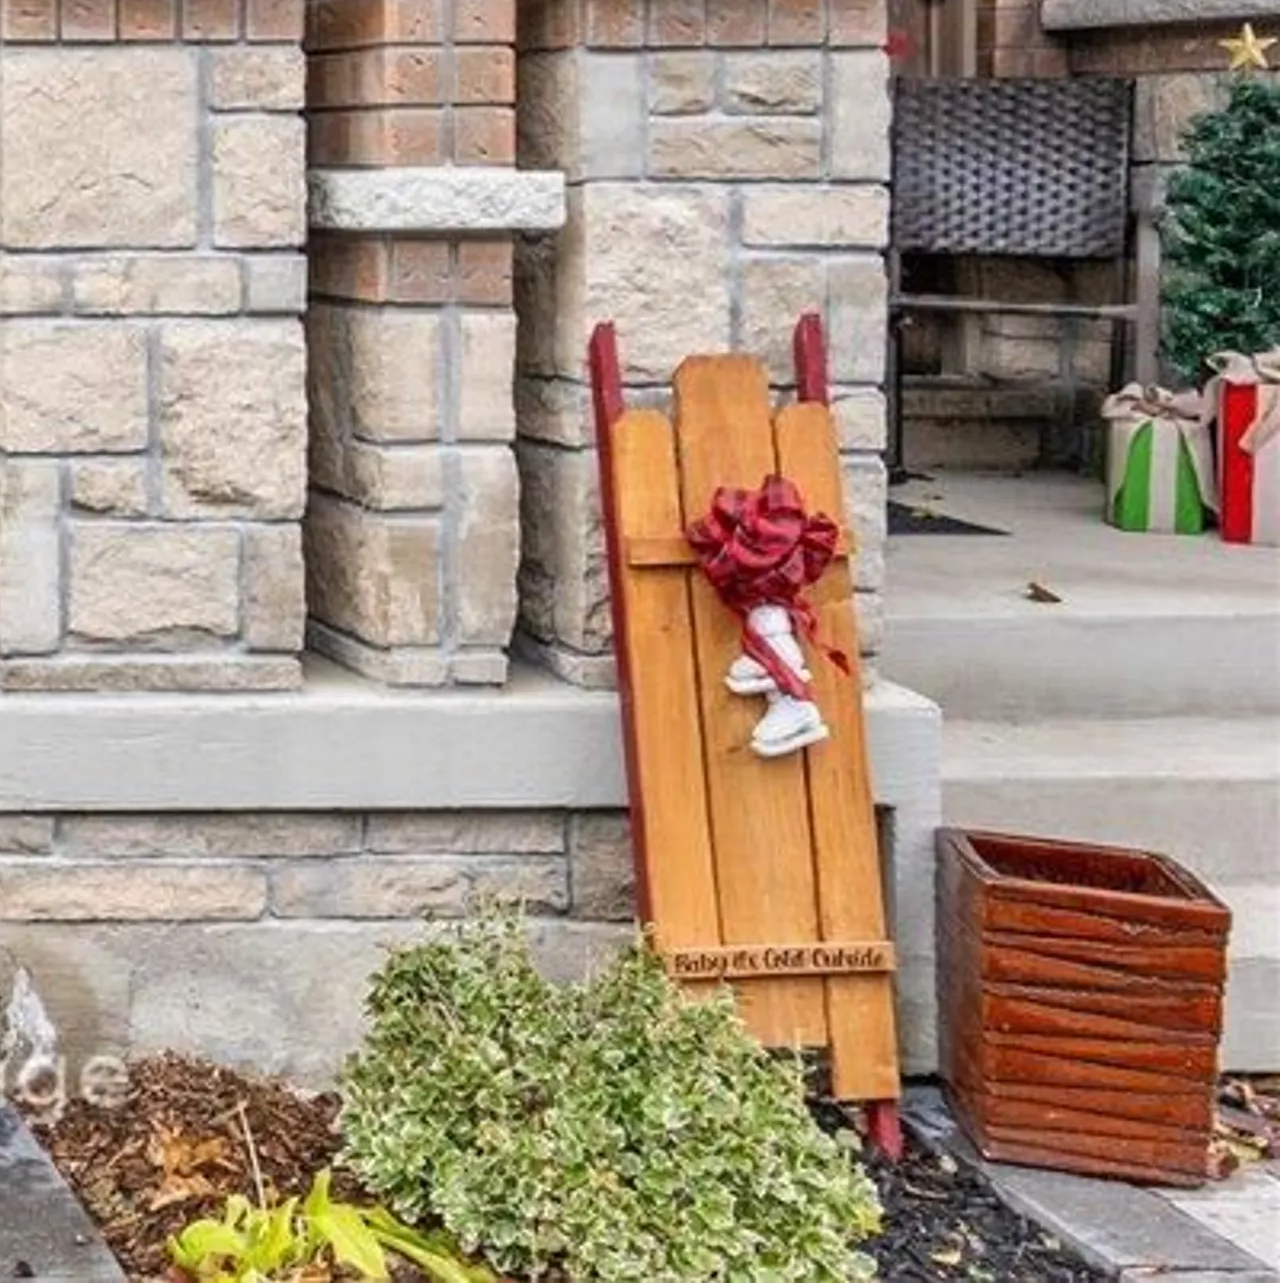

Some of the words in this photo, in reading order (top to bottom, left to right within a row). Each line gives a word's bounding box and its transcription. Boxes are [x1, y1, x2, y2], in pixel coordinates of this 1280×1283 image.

[675, 952, 727, 976] Baby
[763, 947, 806, 969] Cold
[811, 947, 884, 968] Outside
